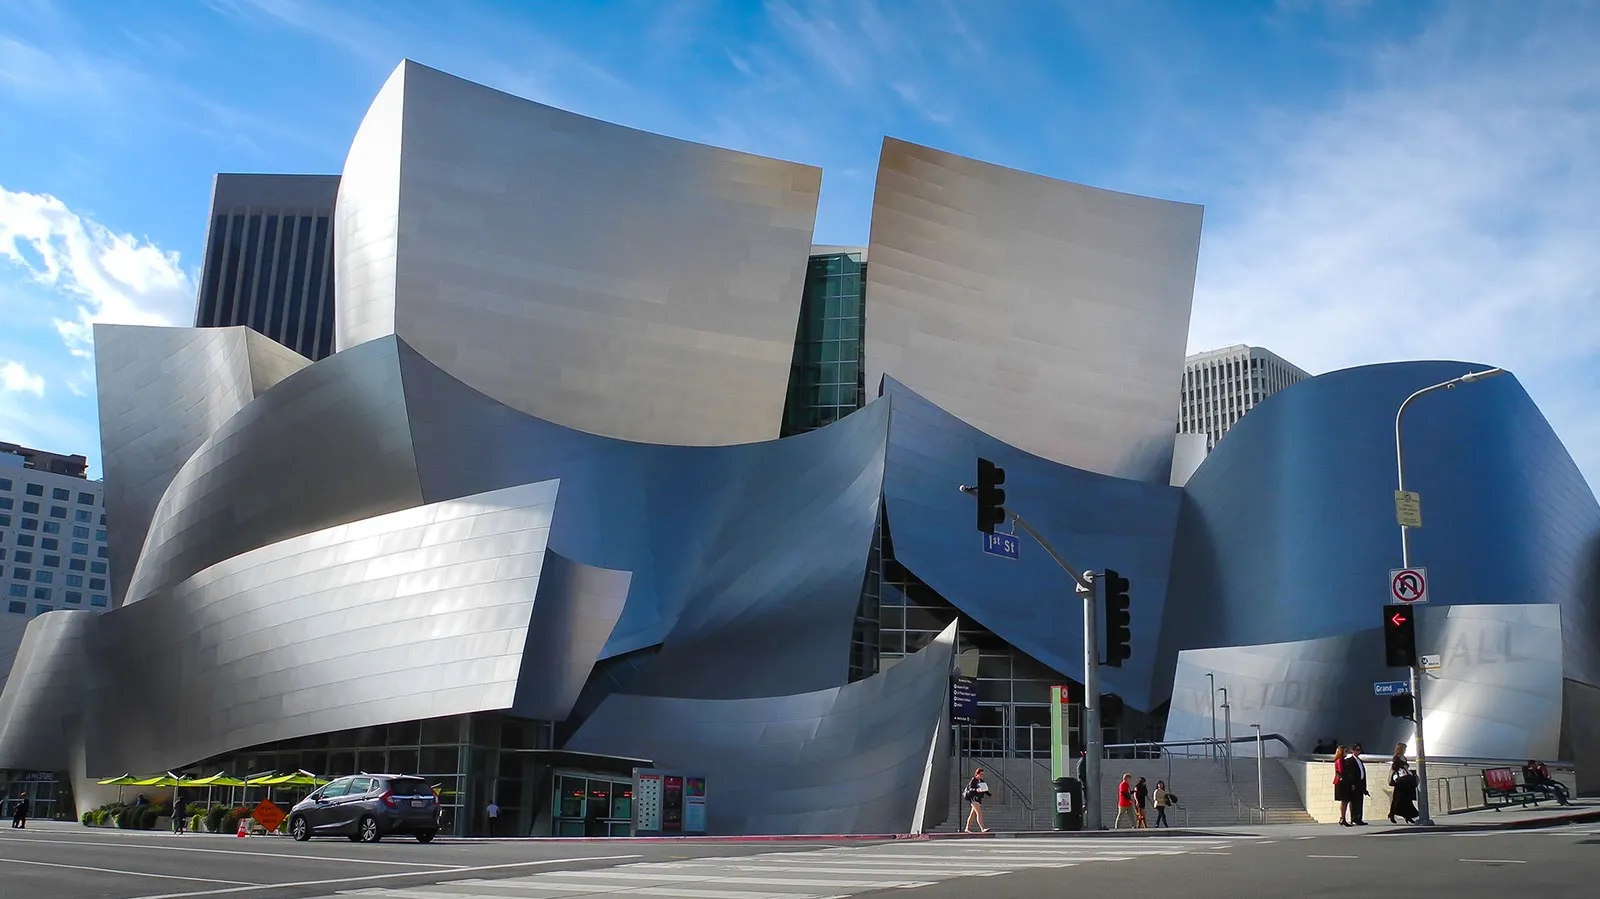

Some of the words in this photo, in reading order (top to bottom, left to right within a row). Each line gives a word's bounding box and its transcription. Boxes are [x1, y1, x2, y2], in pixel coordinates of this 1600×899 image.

[988, 534, 1001, 550] 1st
[1004, 539, 1015, 553] St
[1376, 684, 1392, 692] Grand
